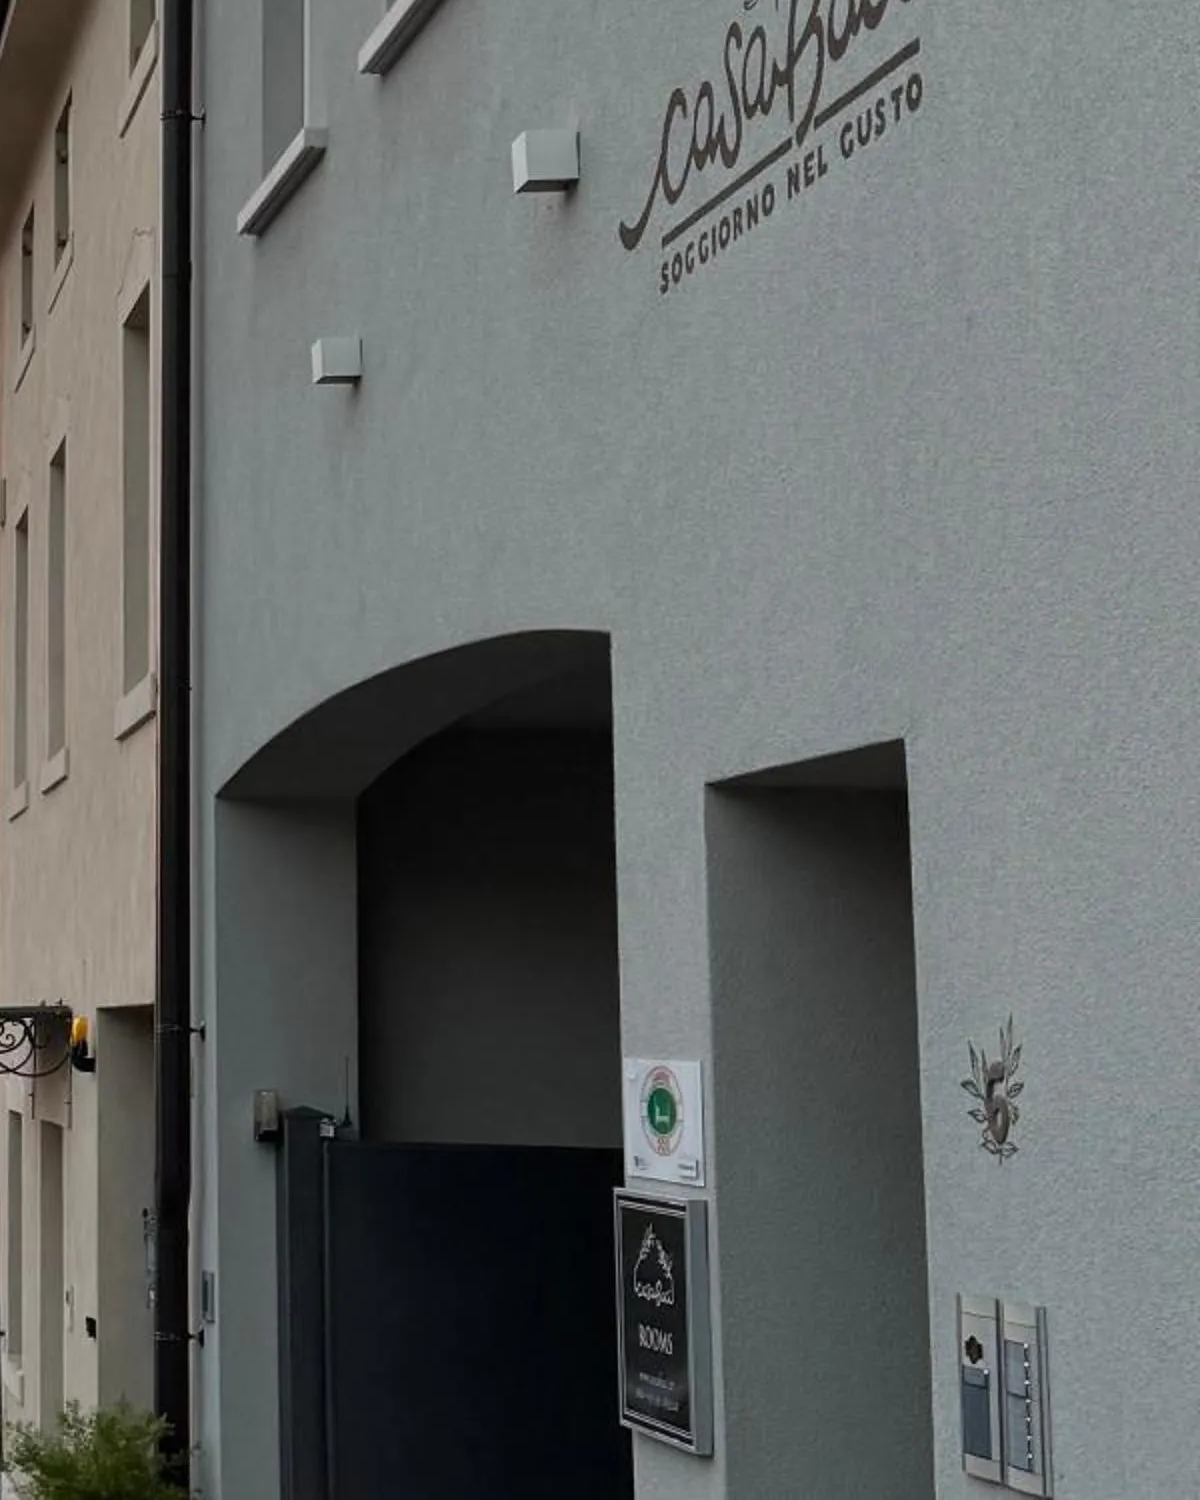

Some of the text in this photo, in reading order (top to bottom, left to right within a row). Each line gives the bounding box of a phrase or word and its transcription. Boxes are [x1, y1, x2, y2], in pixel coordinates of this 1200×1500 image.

[659, 72, 924, 295] SOGGIORNO NEL GUSTO
[639, 1323, 673, 1355] ROOMS
